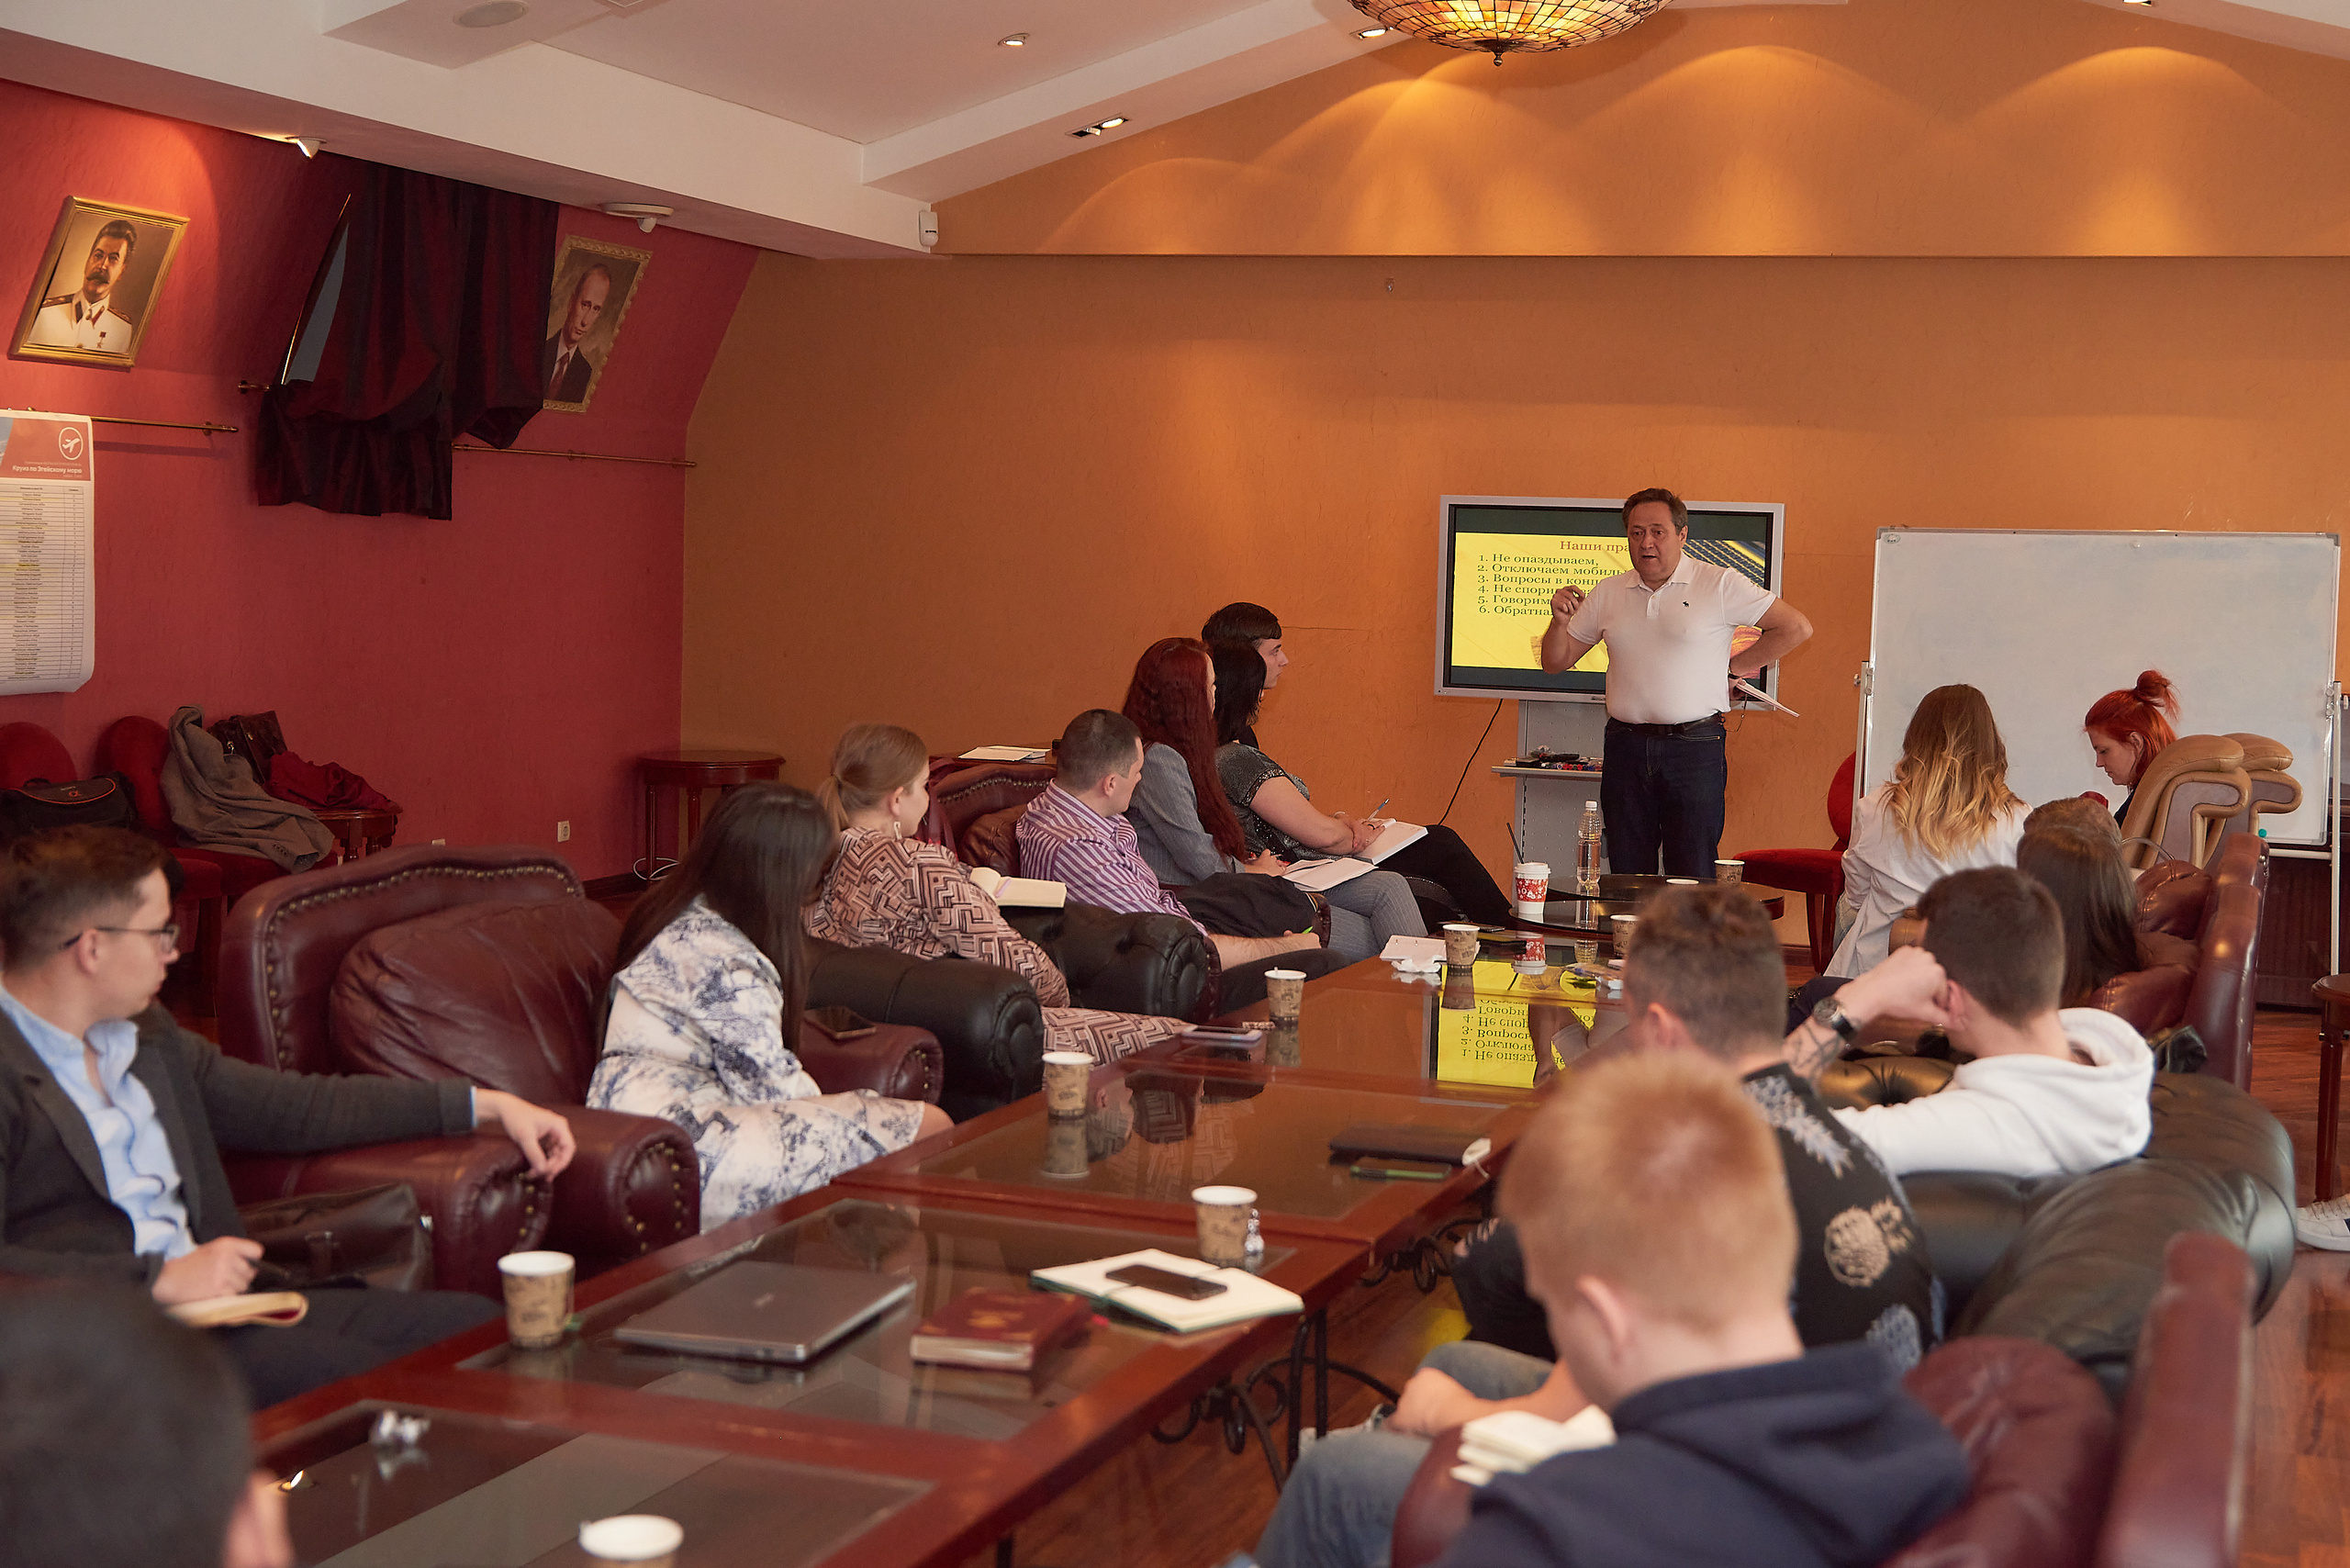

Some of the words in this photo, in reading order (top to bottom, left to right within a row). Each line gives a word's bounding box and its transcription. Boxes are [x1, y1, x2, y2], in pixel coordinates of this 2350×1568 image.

[12, 465, 29, 473] Круиз
[1560, 541, 1602, 551] Наши
[1493, 554, 1511, 562] Не
[1514, 555, 1598, 566] опаздываем,
[1477, 565, 1488, 573] 2.
[1492, 564, 1569, 574] Отключаем
[1477, 575, 1489, 583] 3.
[1494, 574, 1551, 585] Вопросы
[1494, 584, 1512, 593] Не
[1477, 596, 1488, 604] 5.
[1494, 595, 1550, 606] Говорим
